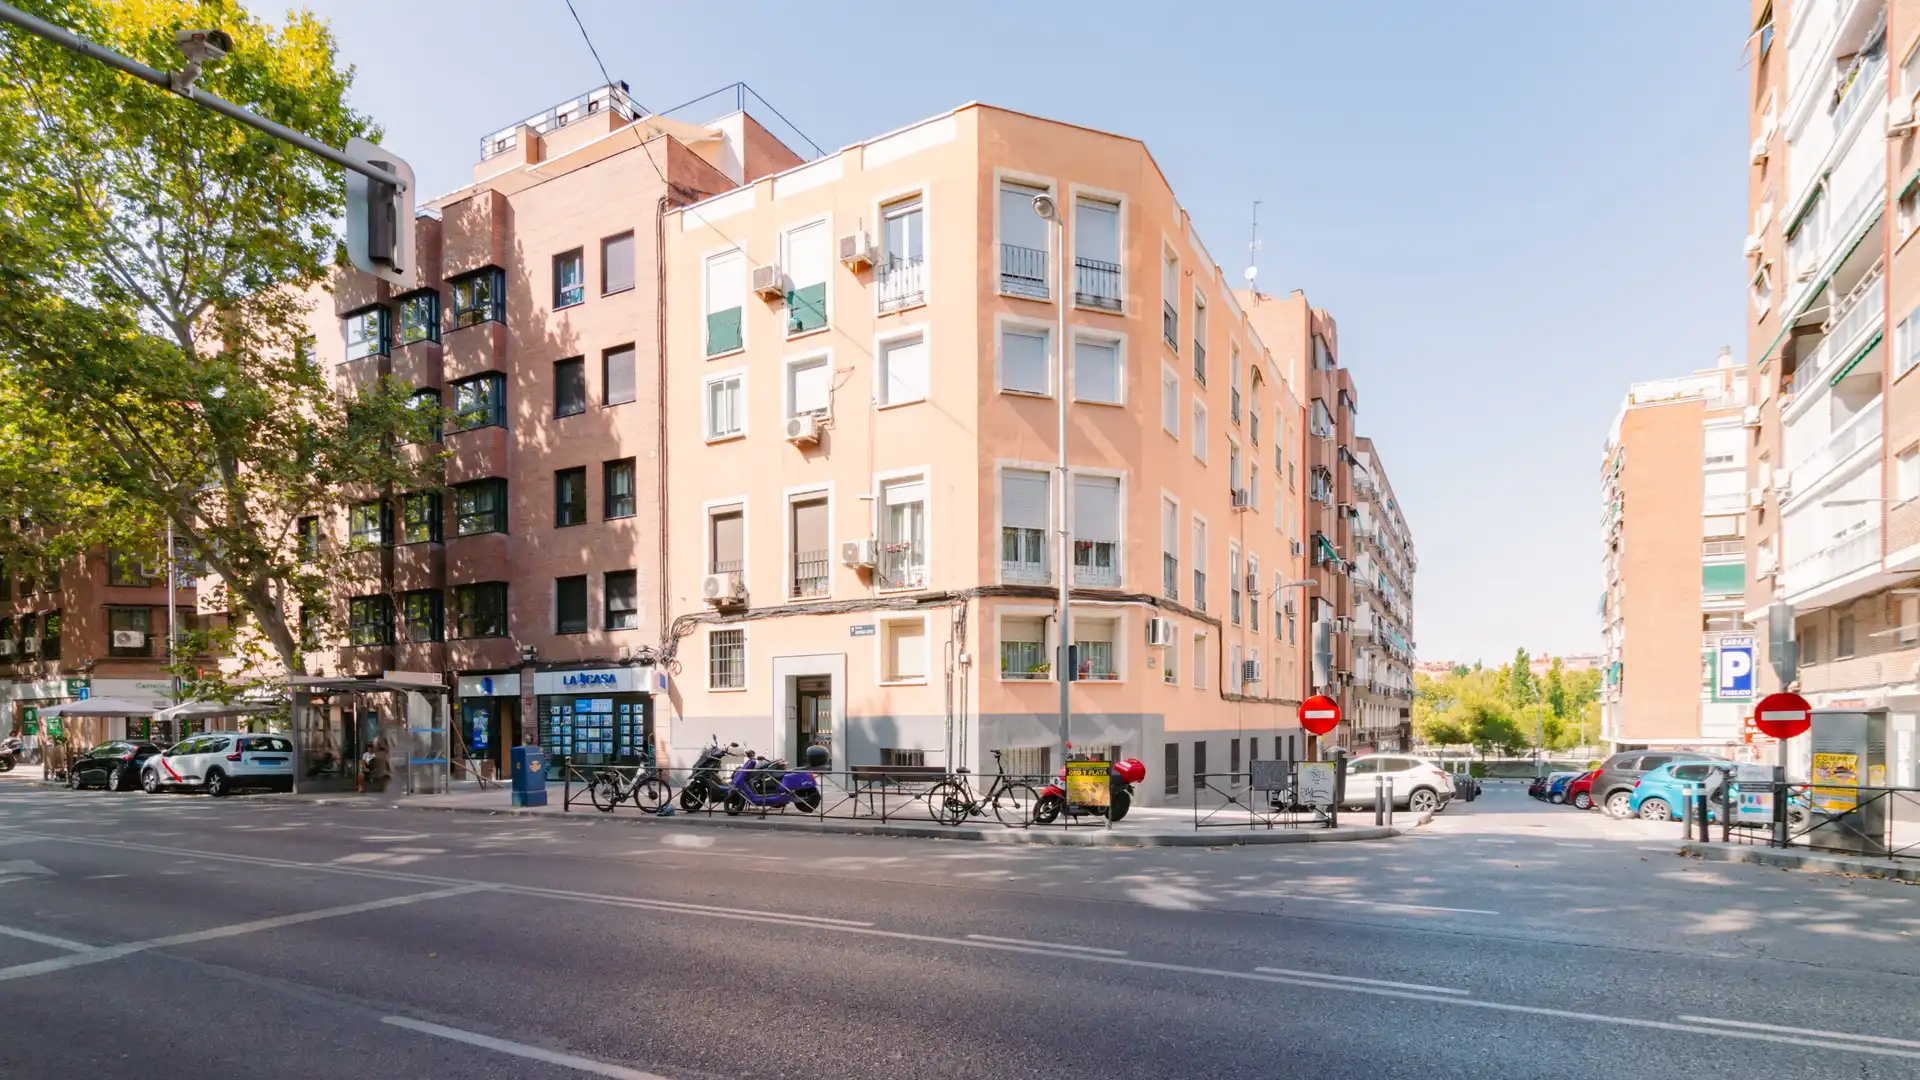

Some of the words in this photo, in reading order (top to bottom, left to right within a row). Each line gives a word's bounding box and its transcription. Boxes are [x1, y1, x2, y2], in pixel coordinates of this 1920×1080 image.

[563, 676, 577, 685] LA
[587, 674, 616, 684] CASA
[1722, 651, 1750, 687] P
